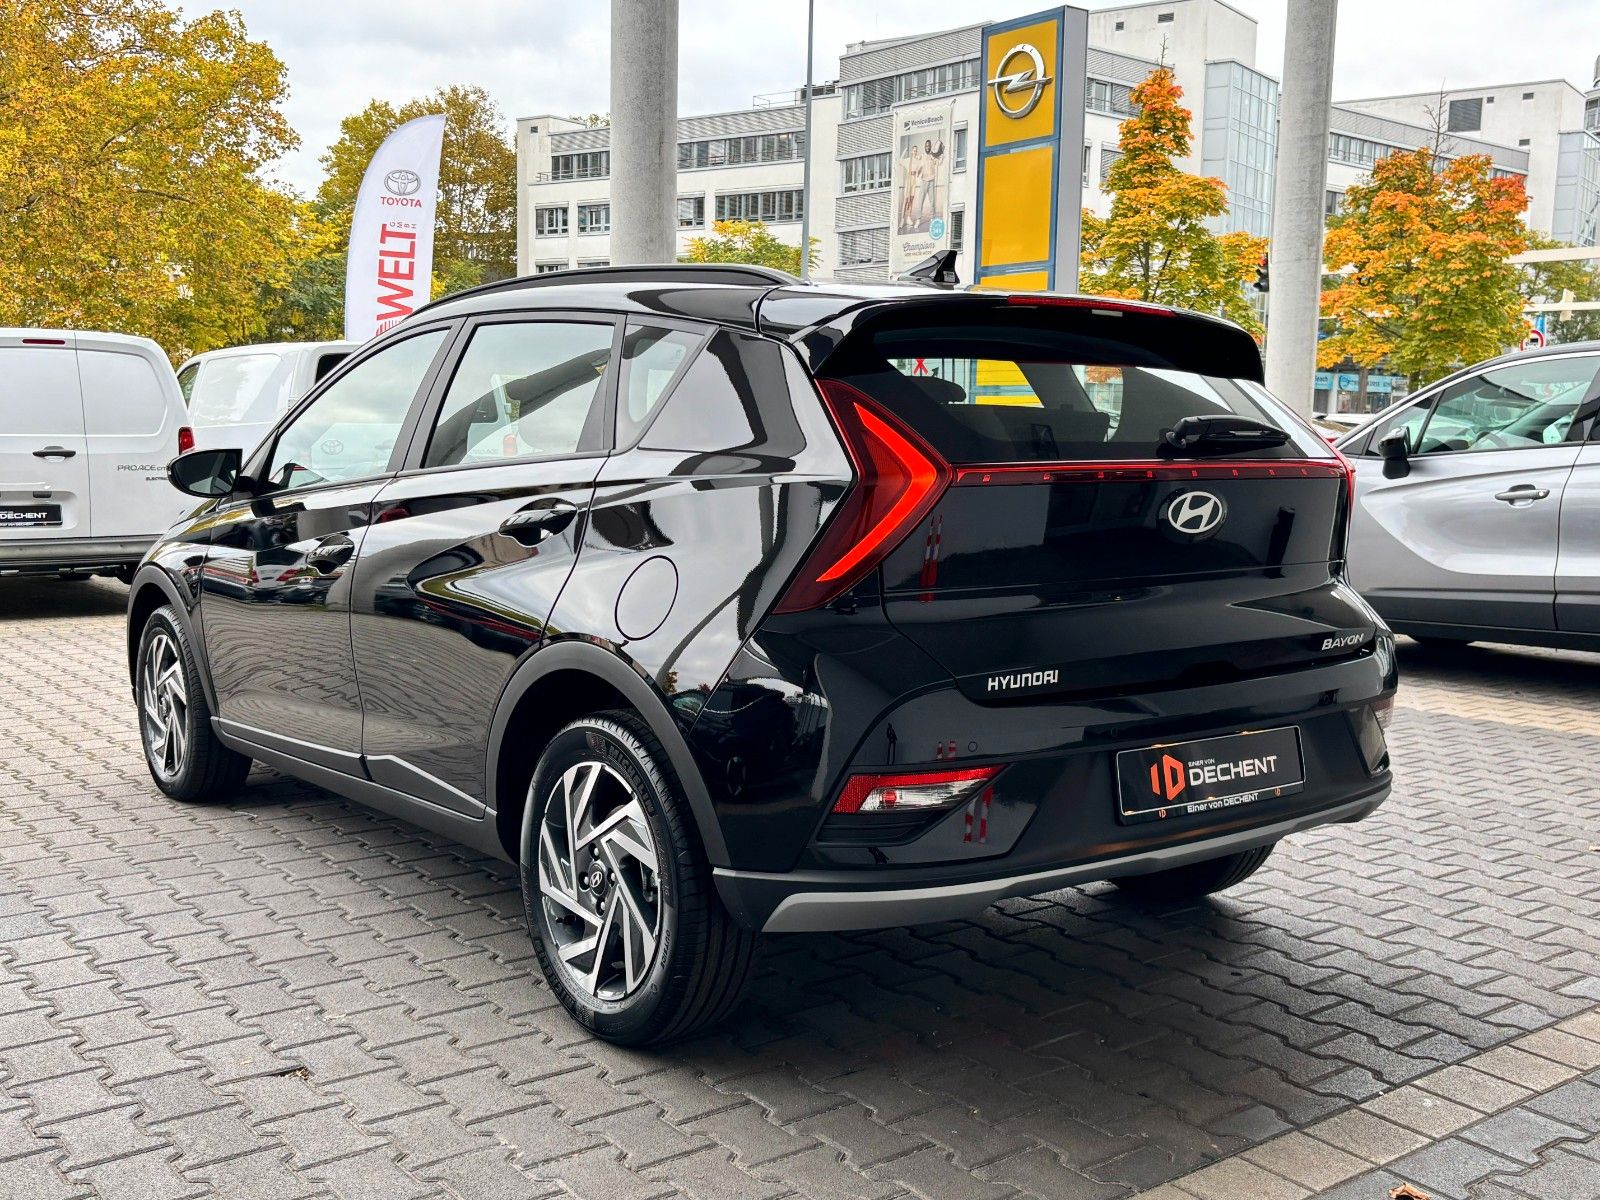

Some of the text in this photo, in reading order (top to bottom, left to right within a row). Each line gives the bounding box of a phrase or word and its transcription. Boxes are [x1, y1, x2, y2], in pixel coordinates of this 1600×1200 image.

[380, 196, 422, 208] TOYOTA
[376, 224, 417, 321] WELT
[1321, 633, 1364, 651] BAYON
[987, 669, 1059, 691] HYUNDAI
[1188, 755, 1278, 787] DECHENT
[1187, 802, 1208, 814] Einer
[1208, 799, 1224, 810] von
[1223, 792, 1259, 807] DECHENT
